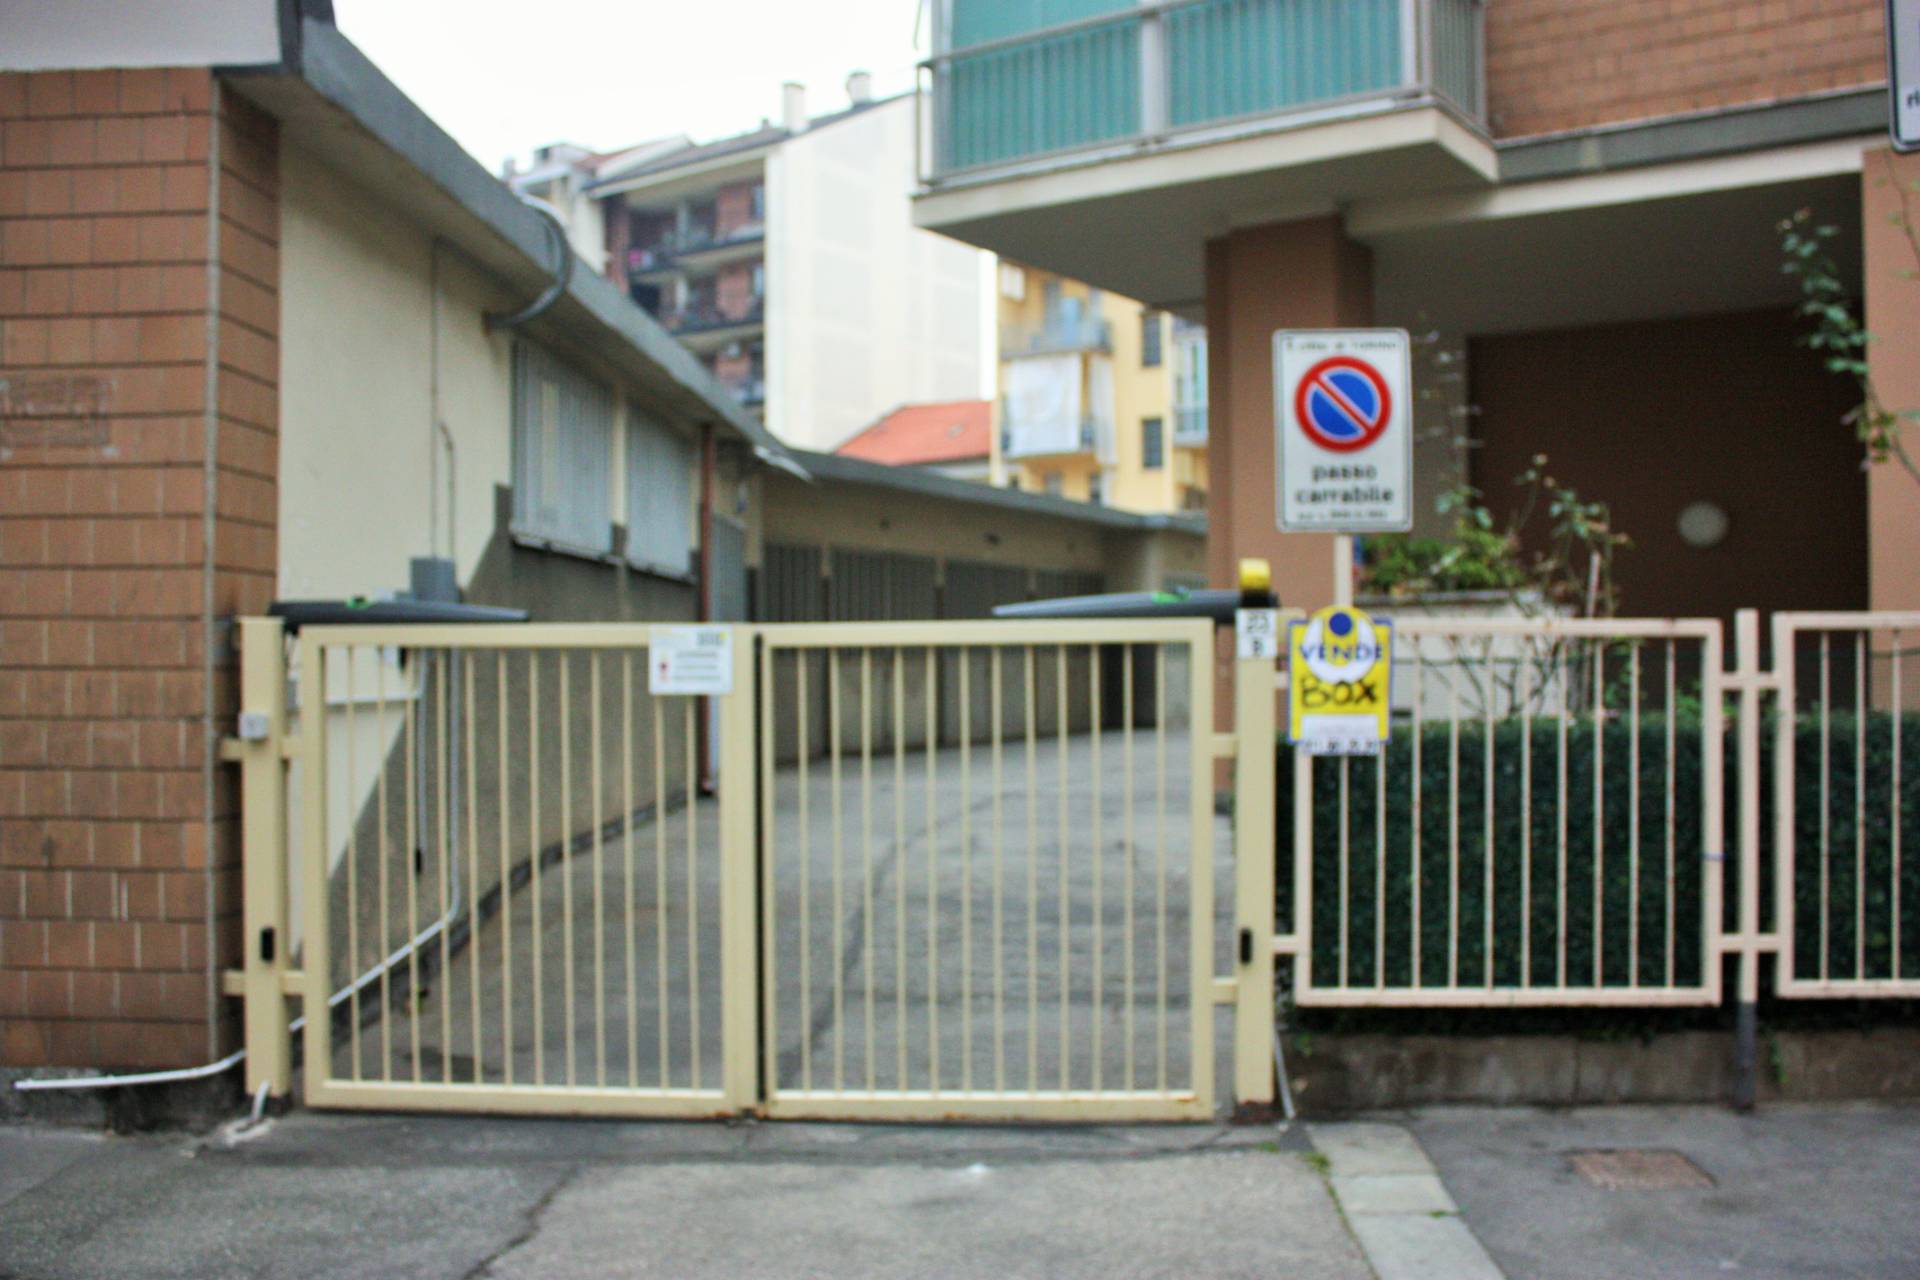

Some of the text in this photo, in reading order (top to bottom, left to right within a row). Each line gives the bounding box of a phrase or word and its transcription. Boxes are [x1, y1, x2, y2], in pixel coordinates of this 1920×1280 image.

[1312, 464, 1377, 482] passo
[1295, 485, 1393, 503] carrabile
[1299, 643, 1383, 660] VENDE
